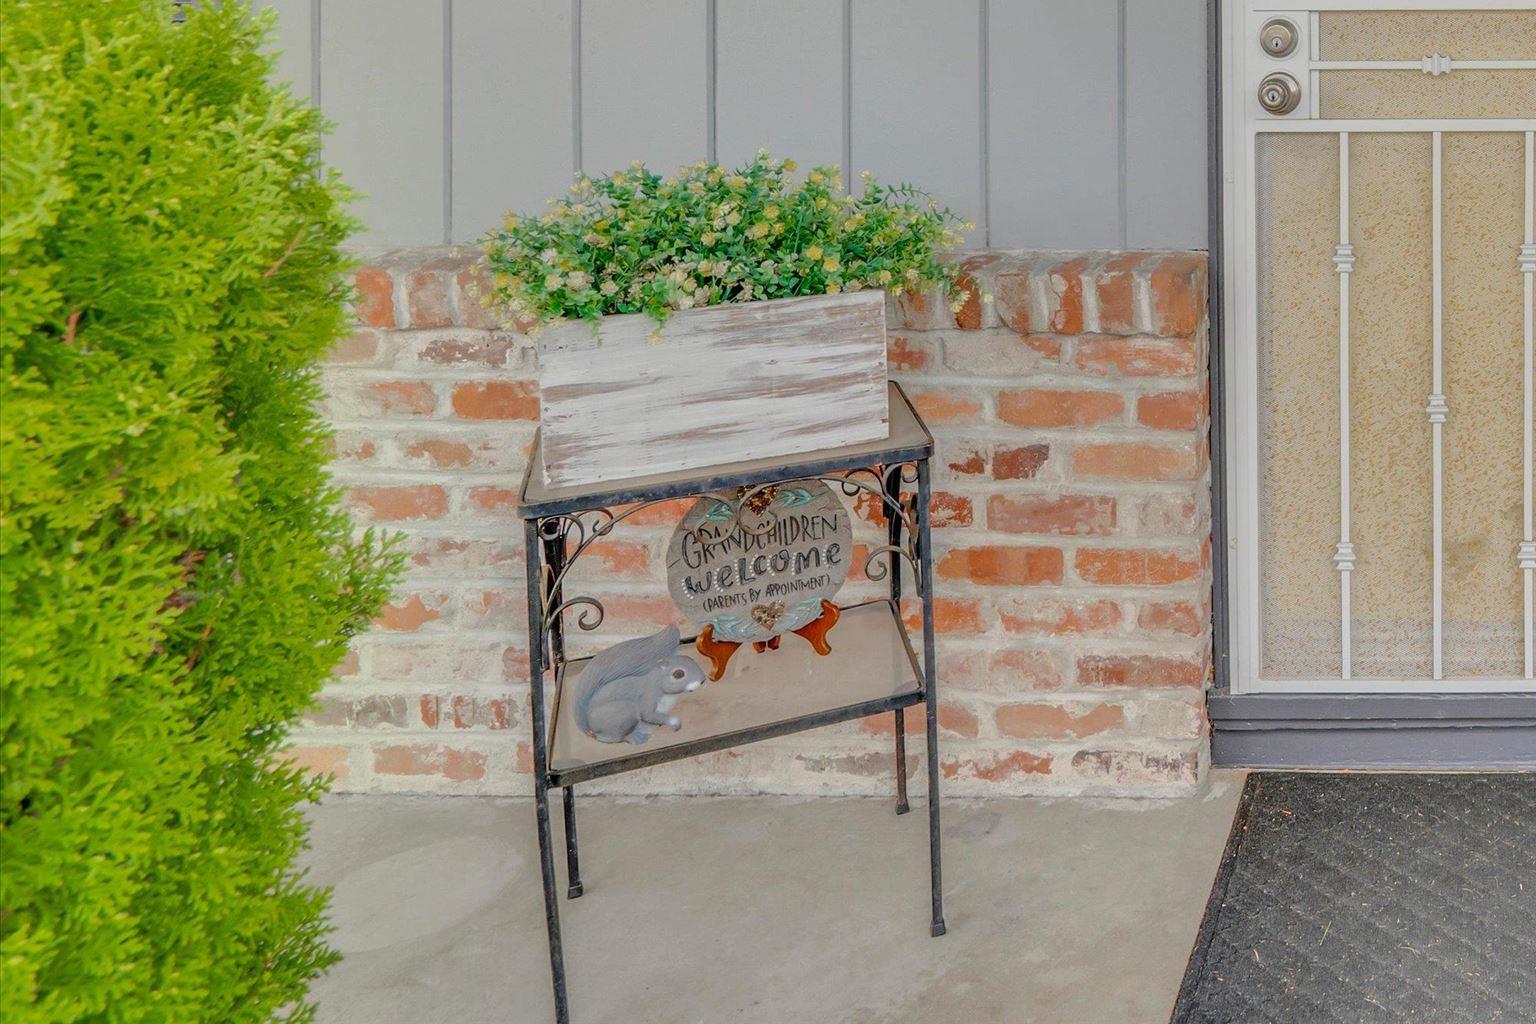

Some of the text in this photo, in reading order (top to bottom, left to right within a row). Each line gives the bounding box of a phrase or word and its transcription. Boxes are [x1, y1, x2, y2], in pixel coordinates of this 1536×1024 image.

[681, 513, 839, 570] GRANDCHILDREN
[702, 573, 831, 614] (PARENTS BY APPOINTMENT)
